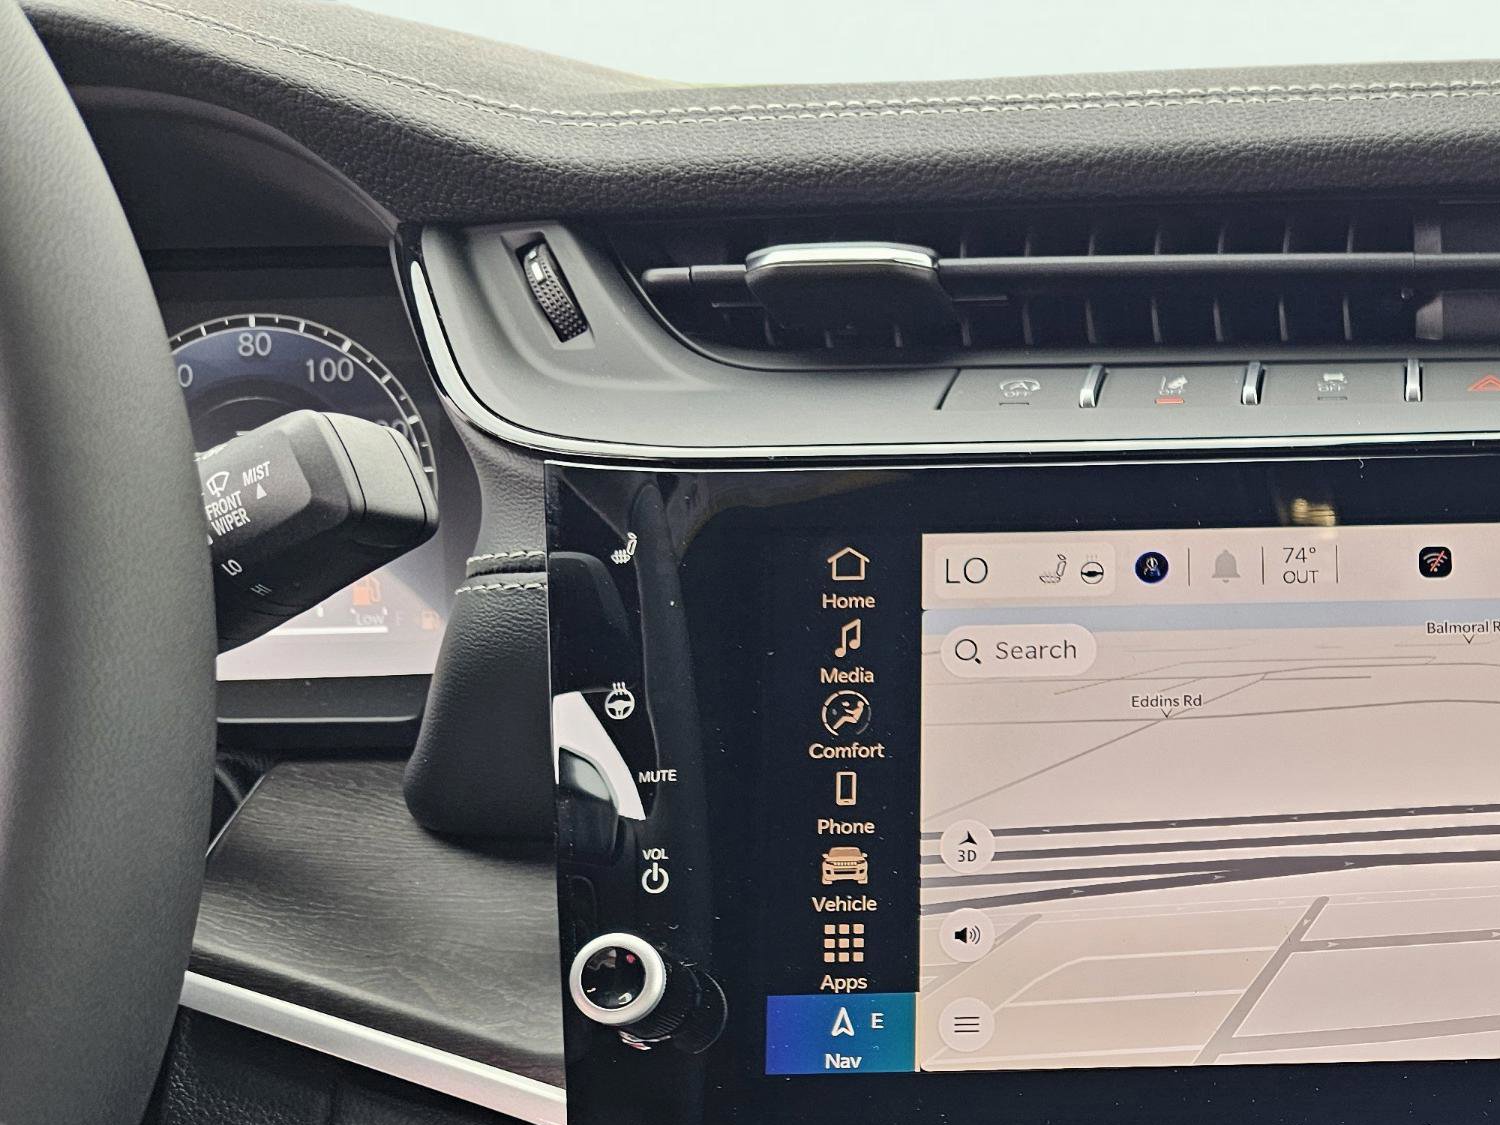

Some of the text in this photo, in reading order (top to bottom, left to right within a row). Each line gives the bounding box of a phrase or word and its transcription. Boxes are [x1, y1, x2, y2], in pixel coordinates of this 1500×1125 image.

[238, 332, 272, 356] 80
[178, 364, 193, 388] 0
[306, 358, 354, 382] 100
[242, 461, 270, 487] MIST
[205, 491, 244, 521] FRONT
[211, 508, 251, 536] WIPER
[1282, 545, 1318, 565] 74°
[221, 559, 243, 576] LO
[944, 556, 990, 584] LO
[1282, 569, 1319, 584] OUT
[251, 583, 272, 597] HI
[822, 593, 876, 609] Home
[1426, 620, 1489, 635] Balmoral
[995, 638, 1078, 660] Search
[820, 667, 874, 684] Media
[1131, 694, 1202, 708] Eddins Rd
[808, 742, 886, 760] Comfort
[638, 769, 678, 784] MUTE
[816, 818, 876, 836] Phone
[642, 848, 669, 861] VOL
[957, 849, 977, 863] 3D
[811, 896, 878, 913] Vehicle
[820, 974, 868, 993] Apps
[871, 1012, 884, 1029] E
[824, 1053, 862, 1070] Nav
